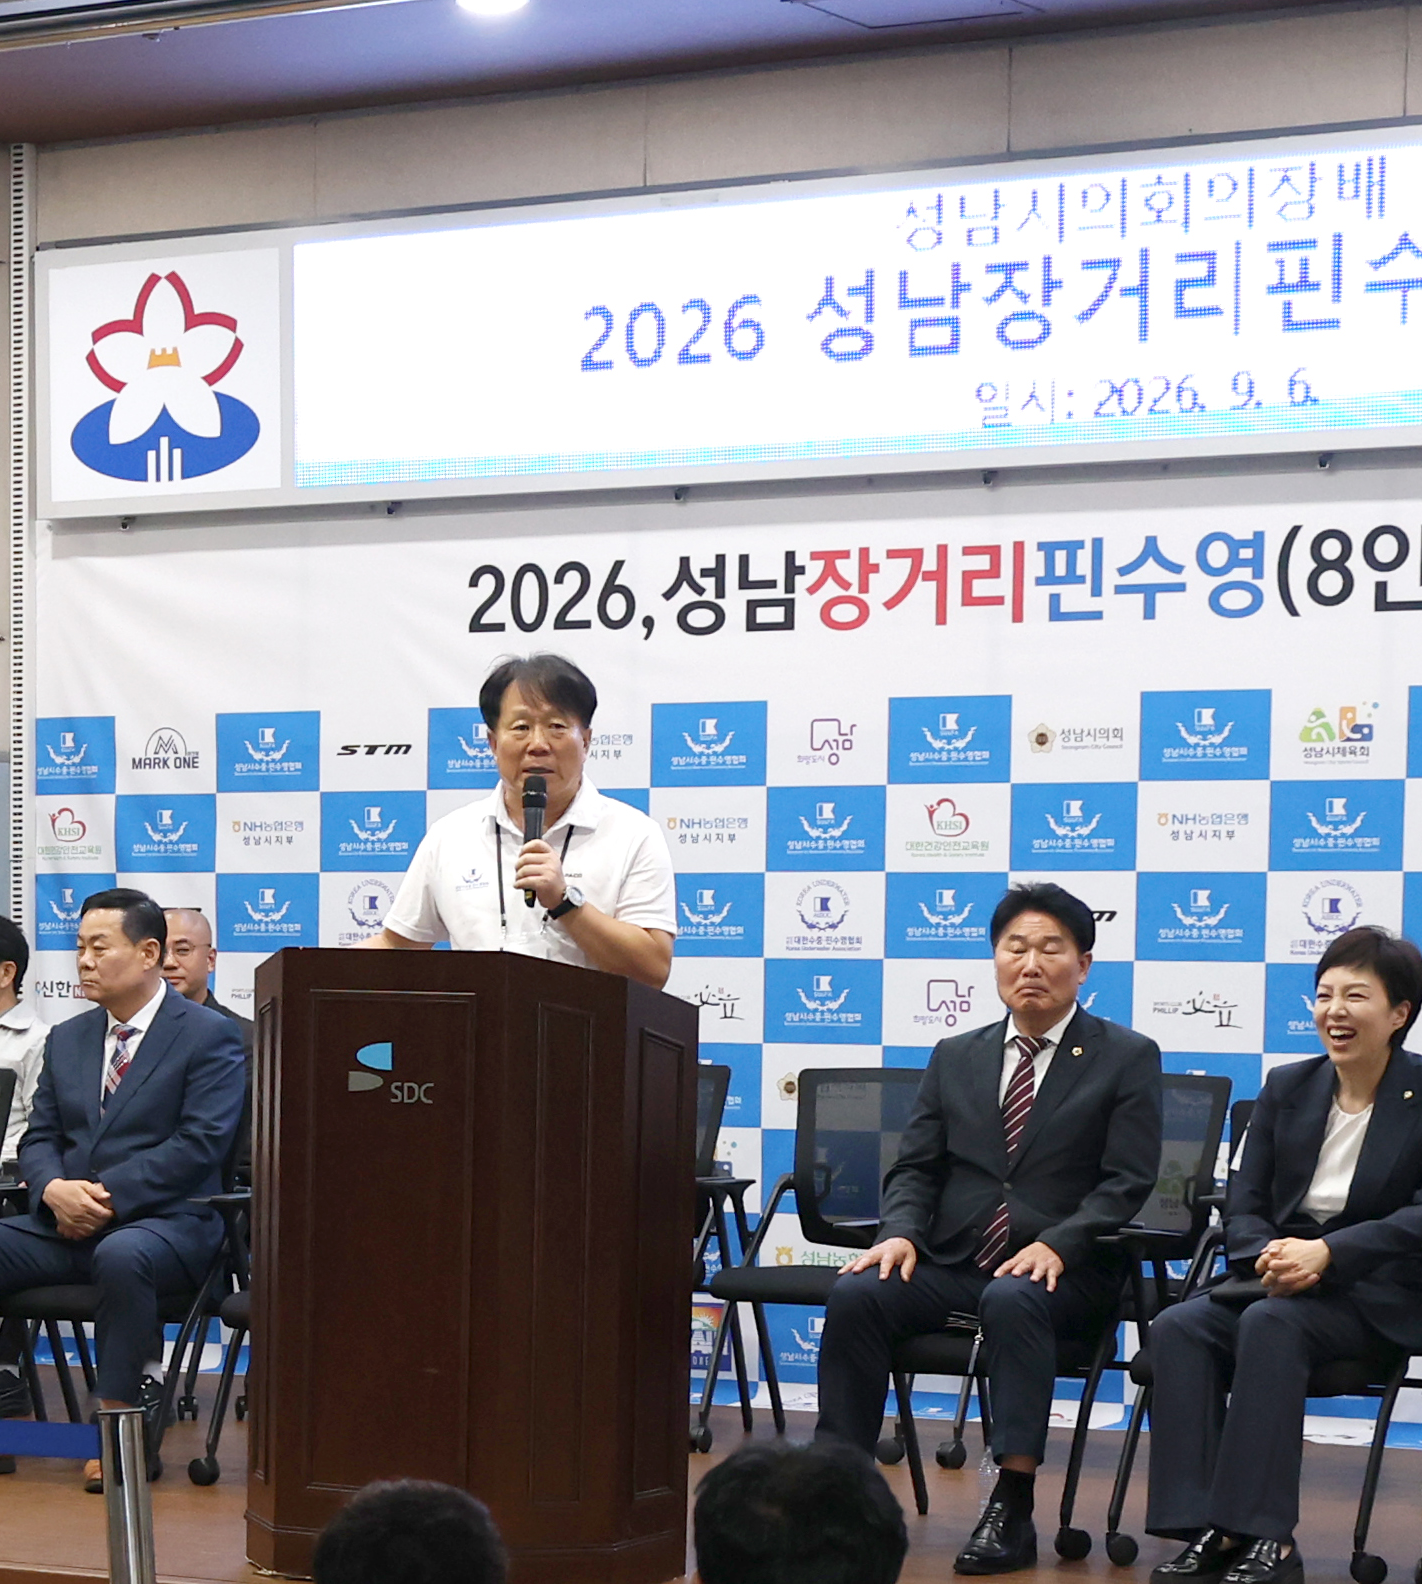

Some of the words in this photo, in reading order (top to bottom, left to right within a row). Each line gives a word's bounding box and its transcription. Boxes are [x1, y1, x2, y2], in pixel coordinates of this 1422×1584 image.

[900, 152, 1389, 252] 성남시의회의장배
[579, 292, 766, 373] 2026
[974, 376, 1075, 430] 일시:
[1060, 727, 1124, 742] 성남시의회
[132, 757, 170, 770] MARK
[174, 756, 199, 769] ONE
[1302, 745, 1370, 758] 성남시체육회
[390, 1081, 435, 1105] SDC
